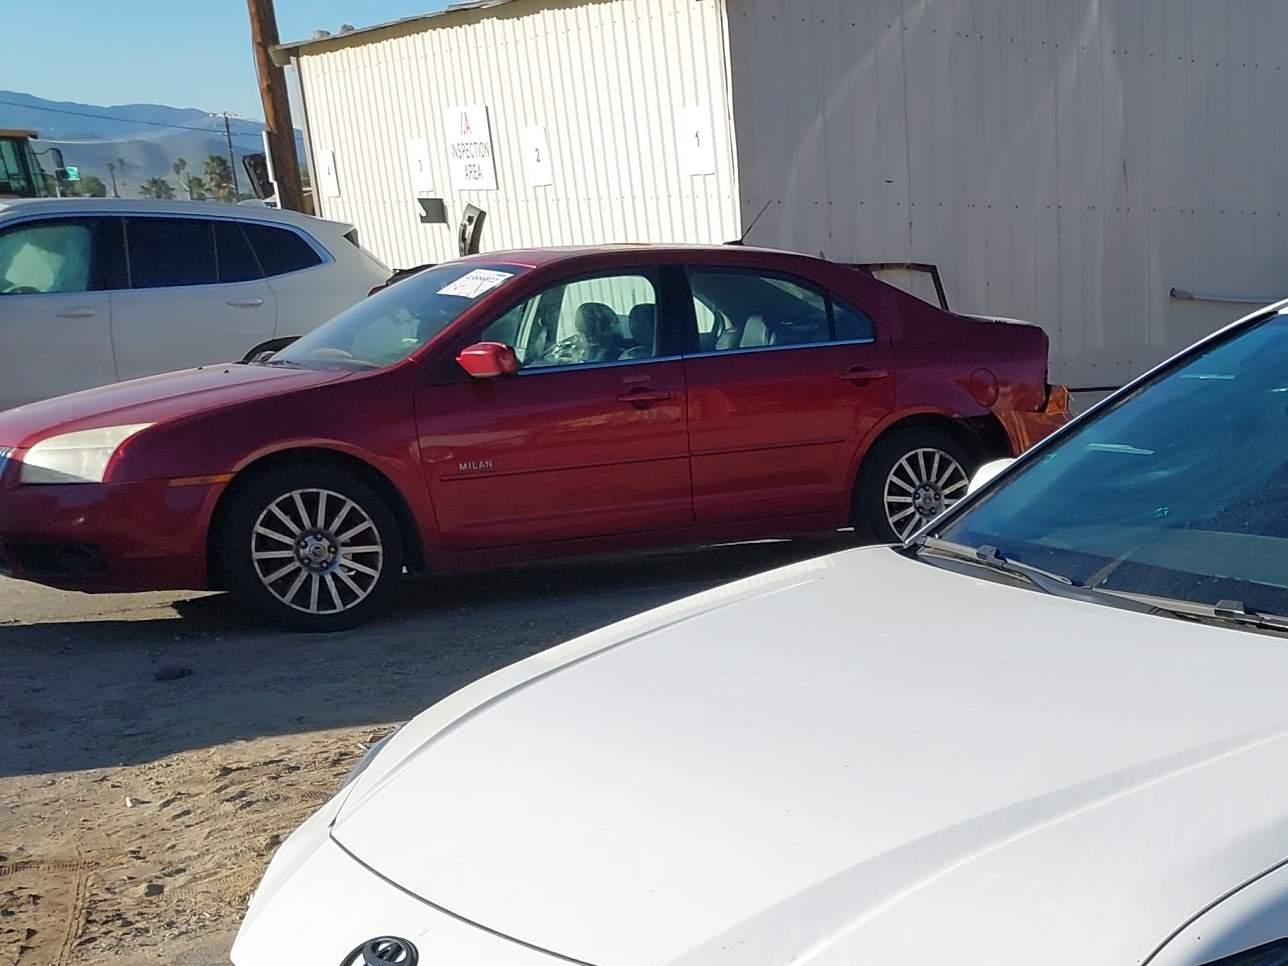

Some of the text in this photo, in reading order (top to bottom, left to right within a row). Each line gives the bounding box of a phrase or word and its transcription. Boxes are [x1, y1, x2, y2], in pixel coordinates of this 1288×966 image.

[450, 141, 490, 159] INSPECTION
[464, 163, 483, 180] AREA
[458, 460, 493, 471] MILAN
